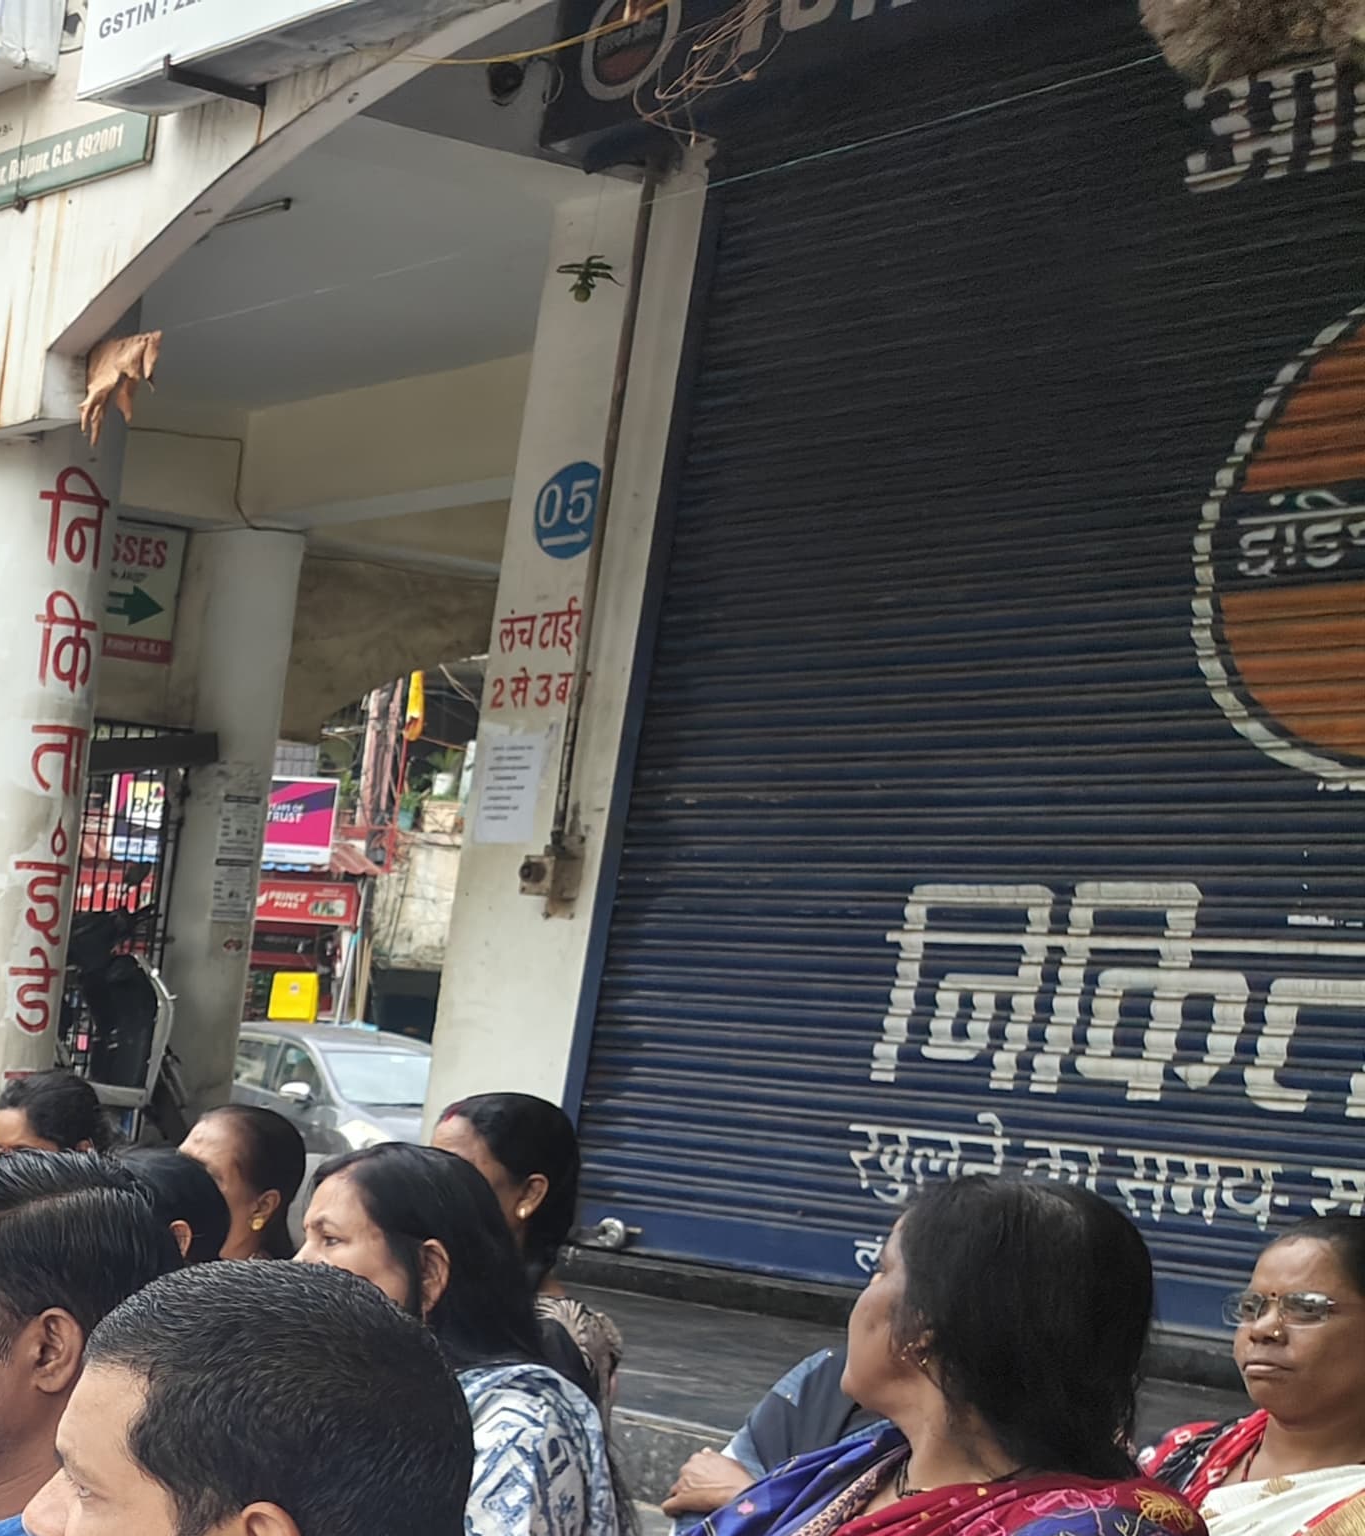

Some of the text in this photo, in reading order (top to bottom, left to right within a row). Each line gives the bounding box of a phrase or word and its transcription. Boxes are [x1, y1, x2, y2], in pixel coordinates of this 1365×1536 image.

[99, 0, 157, 39] GSTIN
[75, 123, 126, 161] 492001
[537, 479, 597, 528] 05
[499, 609, 538, 653] लंच
[490, 678, 505, 710] 2
[510, 667, 532, 709] से
